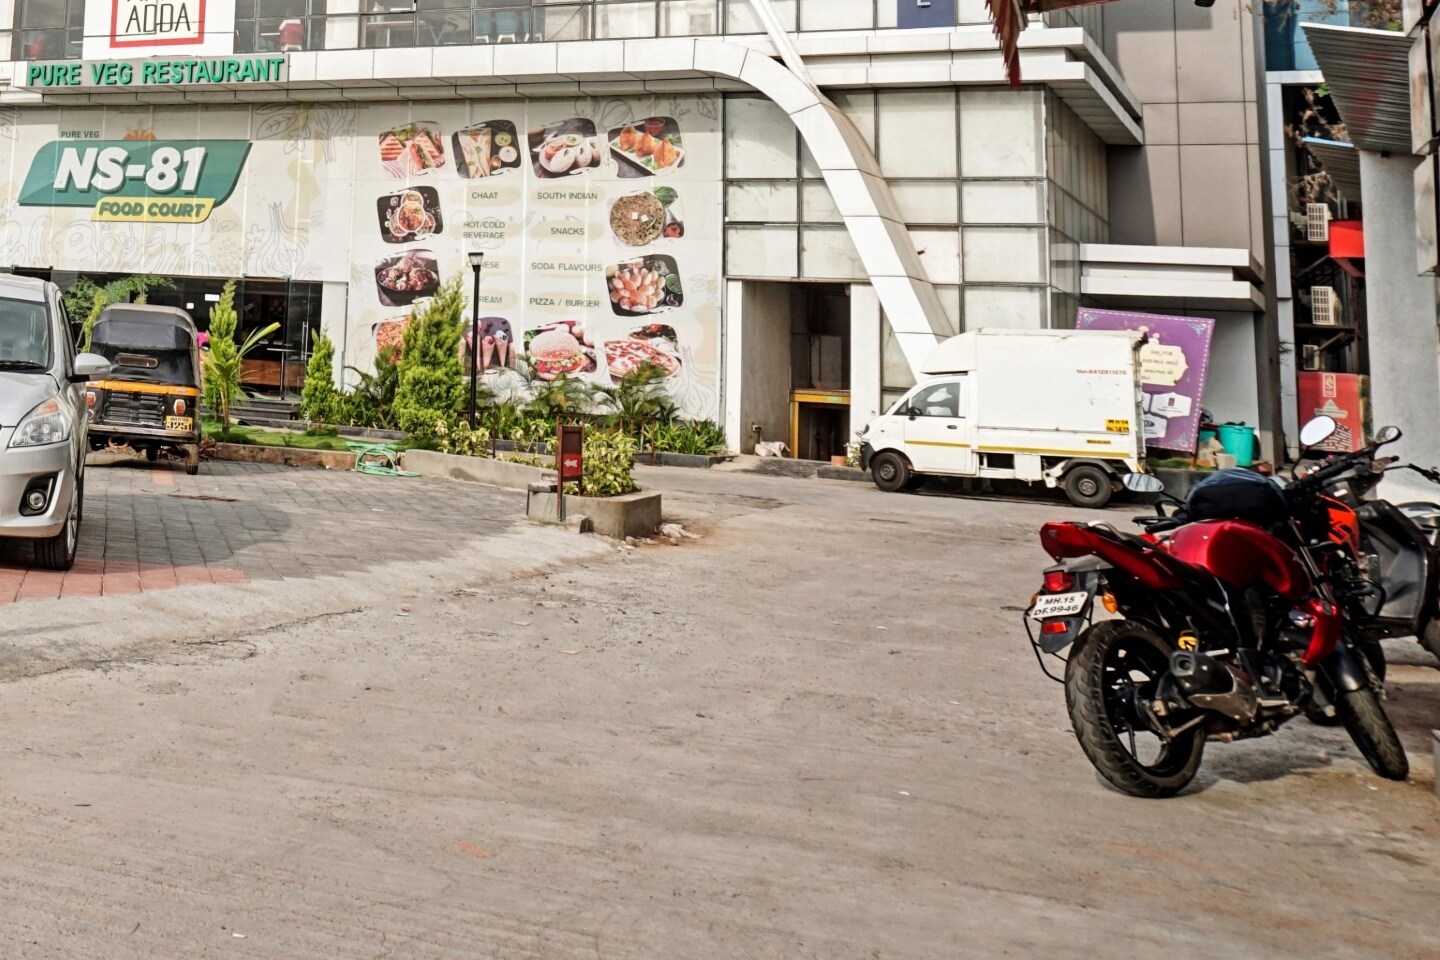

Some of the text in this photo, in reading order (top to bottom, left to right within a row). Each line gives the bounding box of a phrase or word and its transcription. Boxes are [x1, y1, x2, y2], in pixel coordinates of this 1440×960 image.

[125, 3, 191, 34] ADDA
[27, 57, 286, 87] PURE VEG RESTAURANT
[61, 130, 100, 139] PURE VEG
[53, 146, 207, 194] NS-81
[471, 191, 498, 199] CHAAT
[536, 192, 598, 200] SOUTH INDIAN
[98, 201, 205, 218] FOOD COURT
[463, 221, 505, 229] HOT/COLD
[463, 231, 505, 239] BEVERAGE
[550, 227, 585, 235] SNACKS
[531, 262, 603, 272] SODA FLAVOURS
[478, 296, 503, 304] REAM
[529, 297, 555, 306] PIZZA
[565, 299, 600, 308] BURGER
